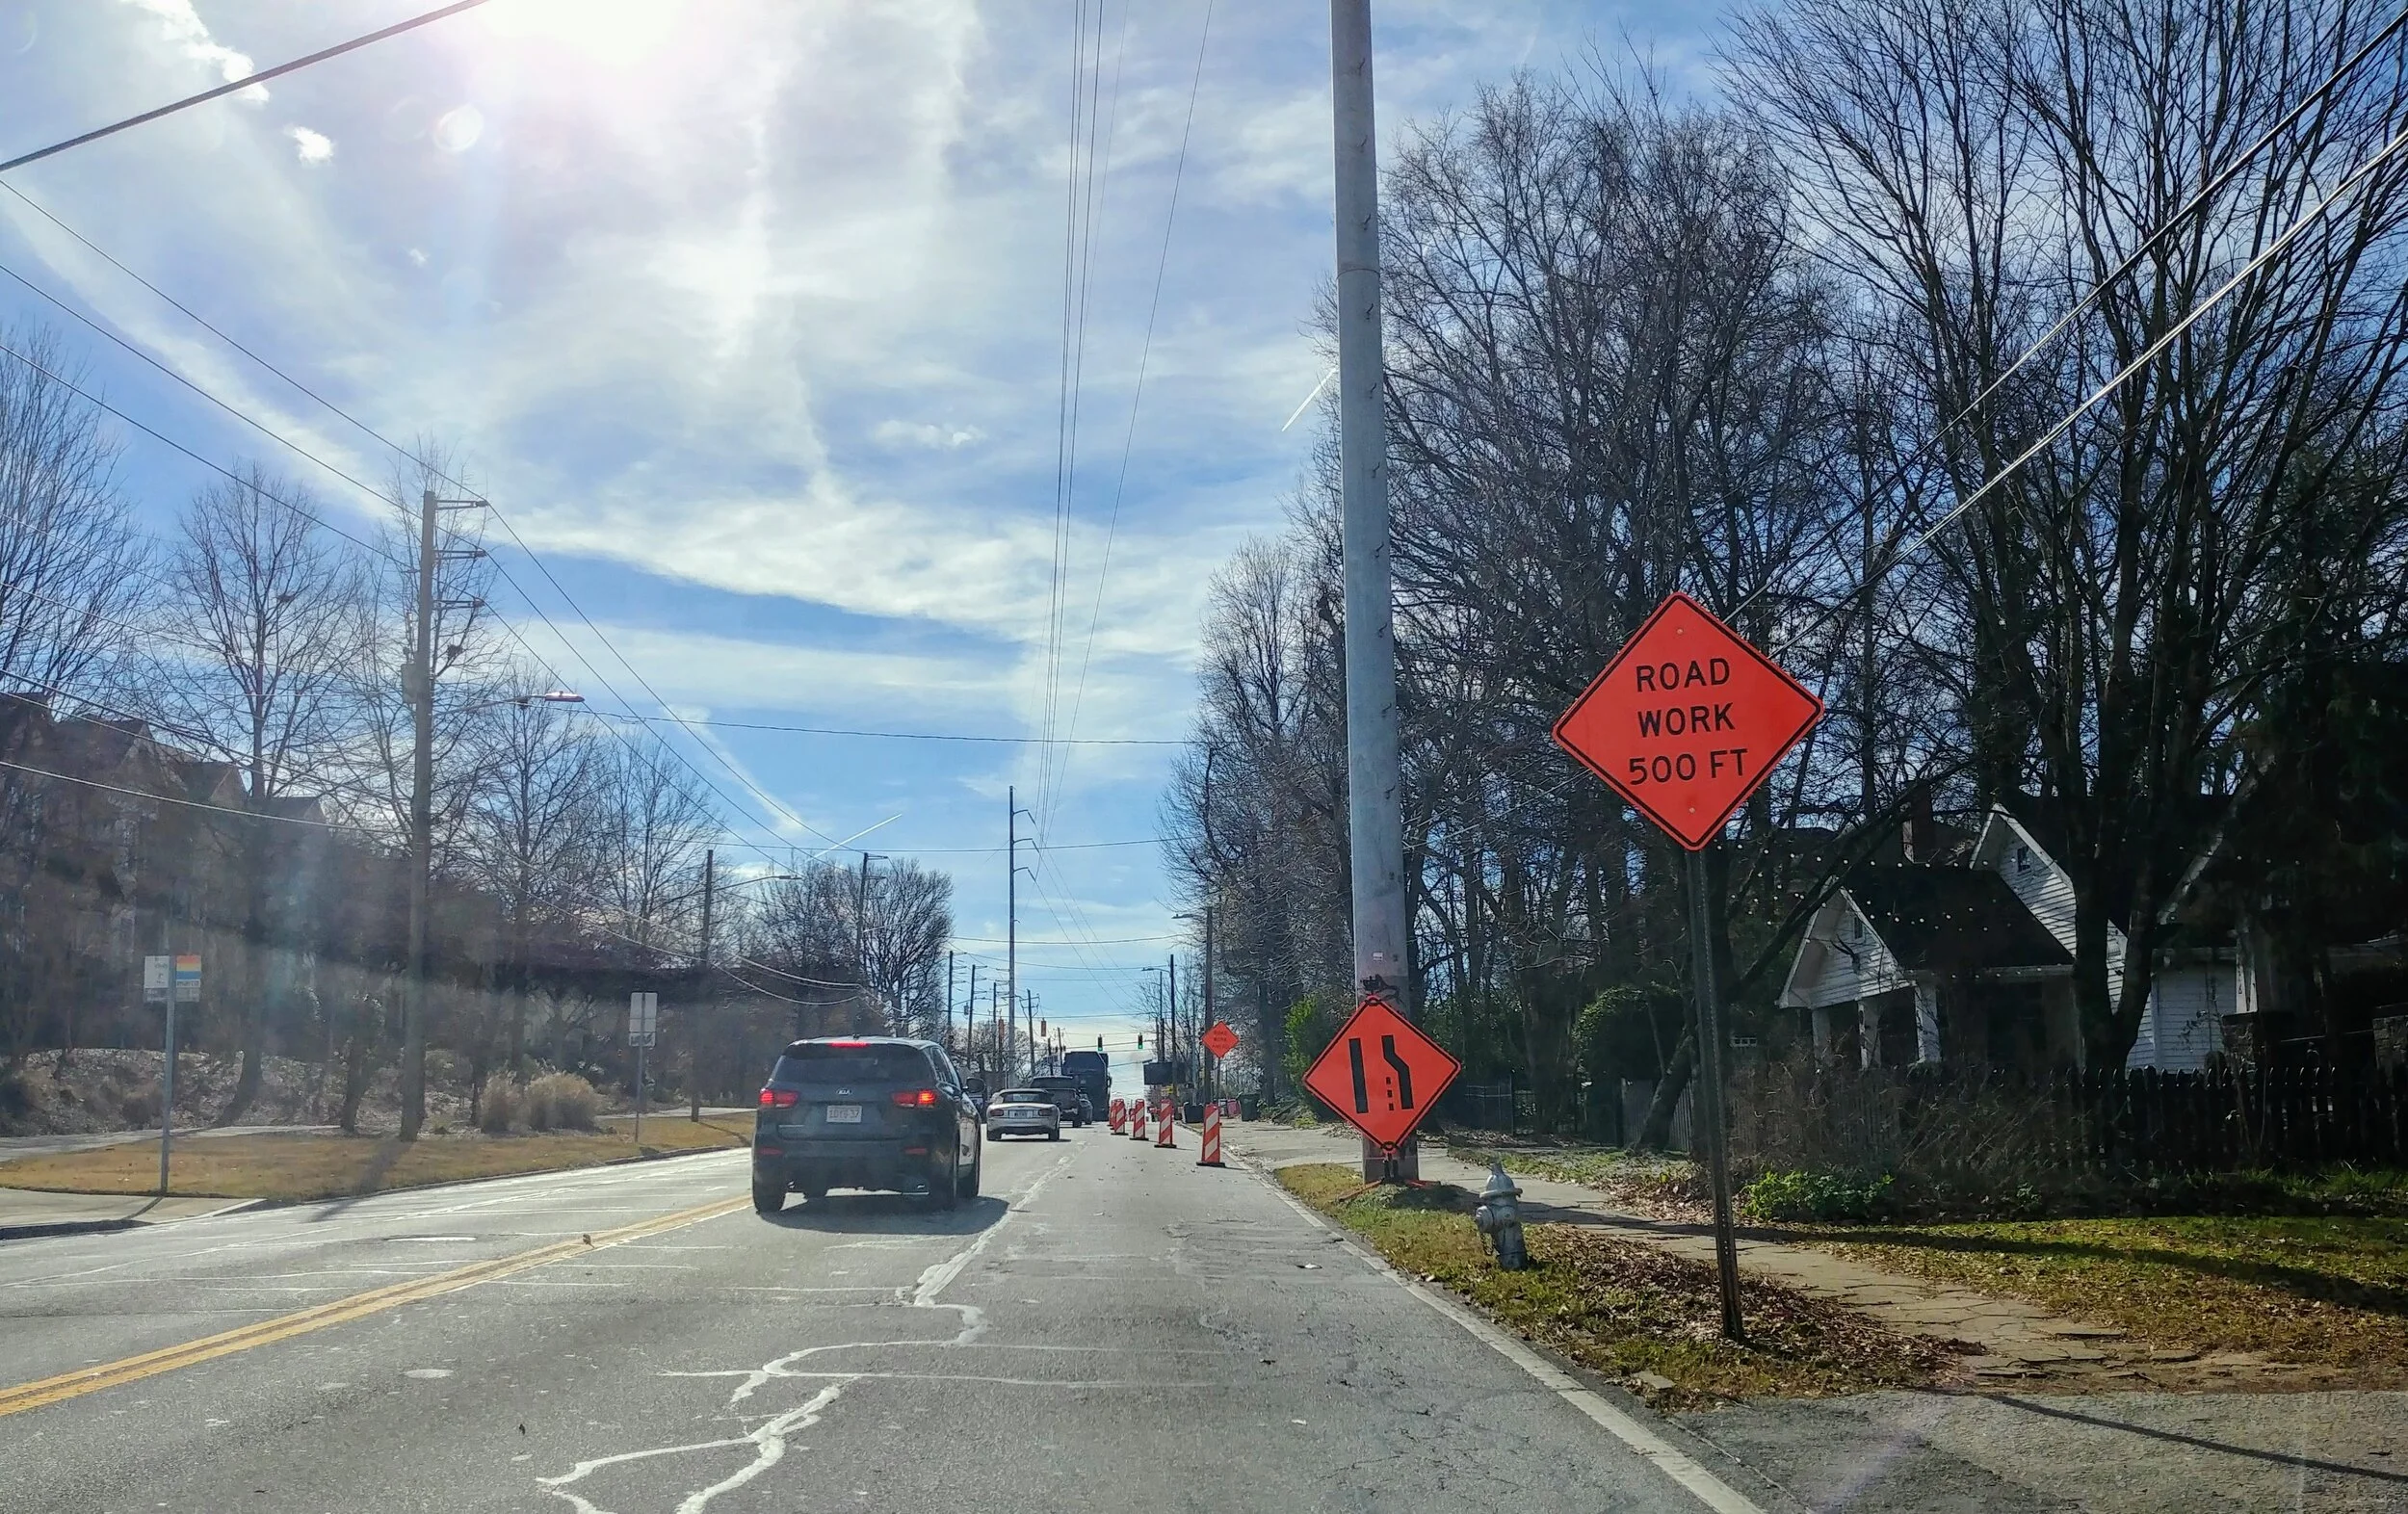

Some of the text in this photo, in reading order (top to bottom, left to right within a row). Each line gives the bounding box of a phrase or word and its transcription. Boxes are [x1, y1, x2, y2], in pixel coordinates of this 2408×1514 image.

[1636, 657, 1730, 692] ROAD
[1637, 702, 1735, 738] WORK
[1629, 748, 1748, 785] 500 FT
